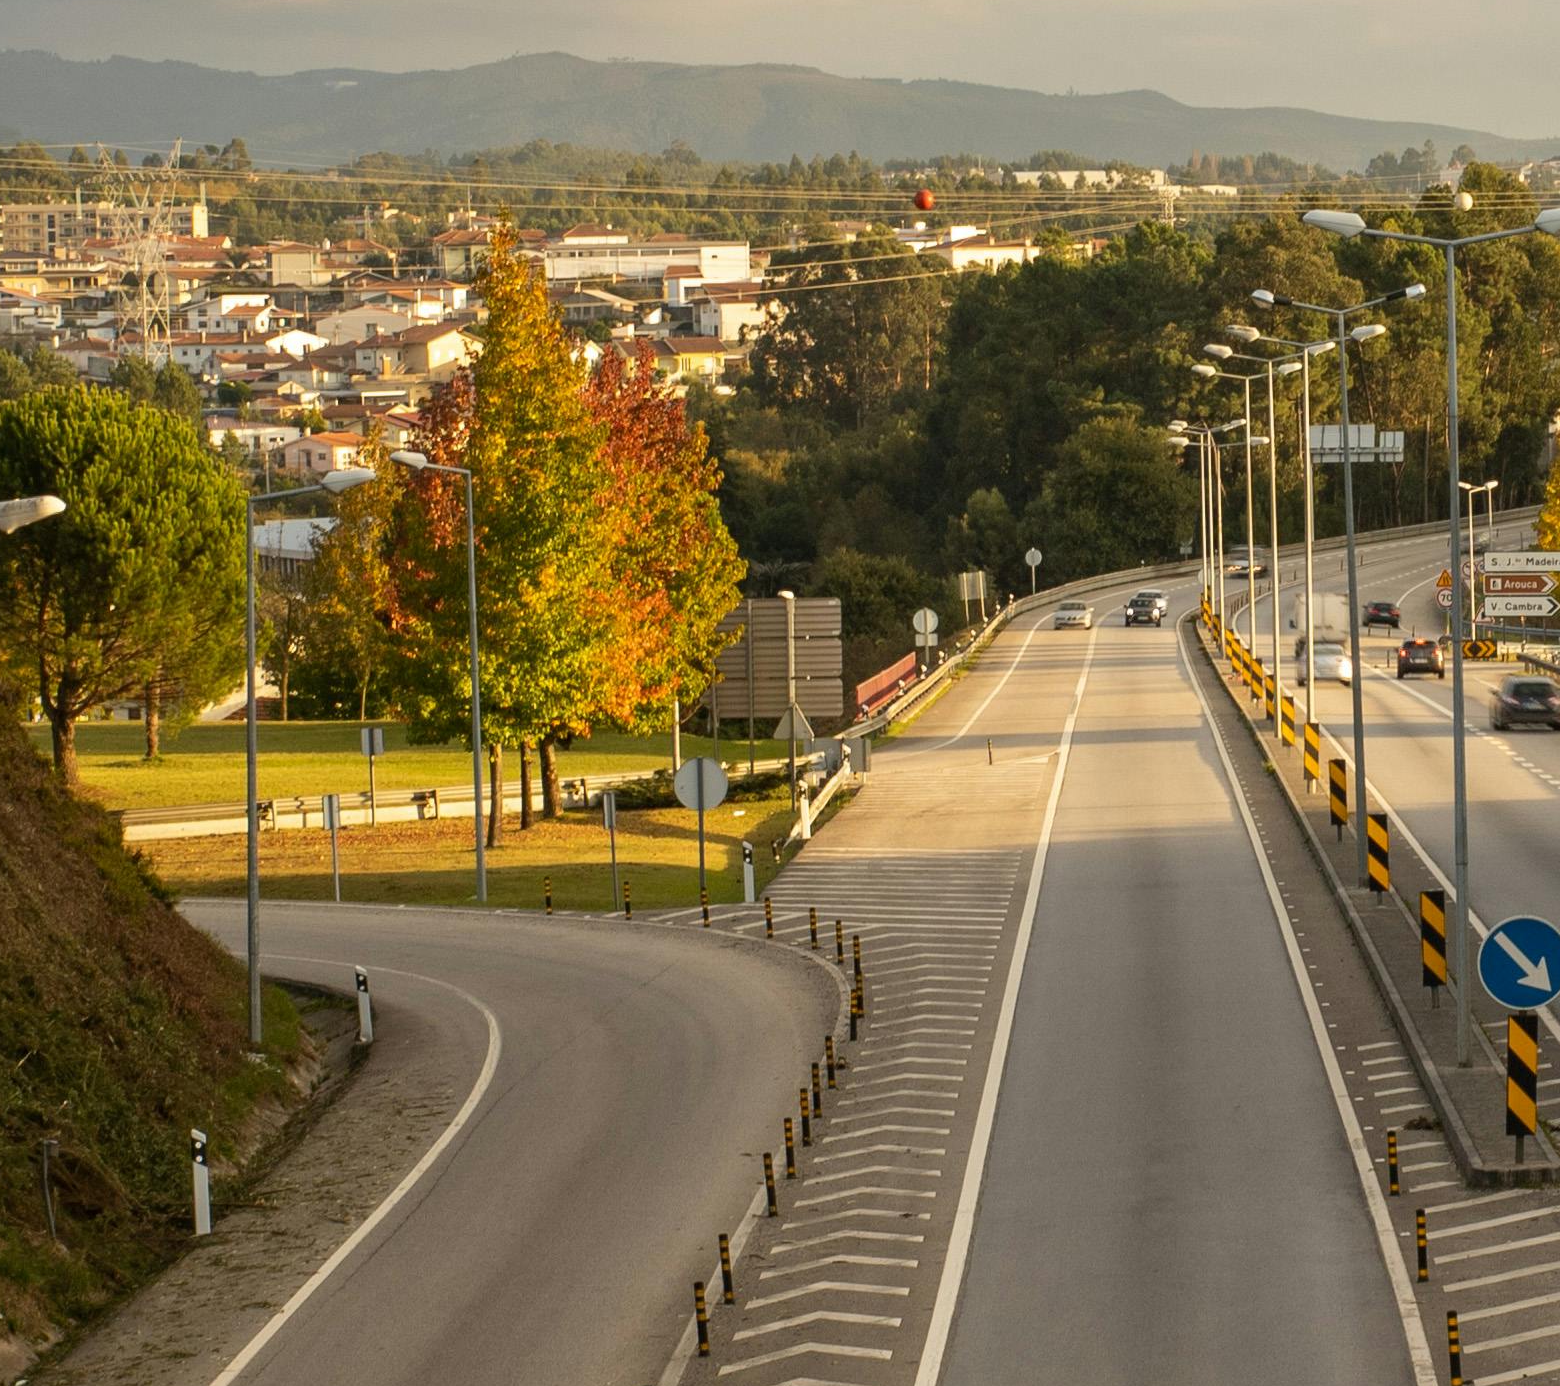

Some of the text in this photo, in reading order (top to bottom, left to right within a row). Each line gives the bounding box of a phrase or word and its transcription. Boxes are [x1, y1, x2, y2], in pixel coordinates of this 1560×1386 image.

[1491, 558, 1501, 566] S.
[1504, 580, 1538, 589] Arouca
[1441, 594, 1453, 603] 70
[1491, 602, 1543, 611] V. Cambra
